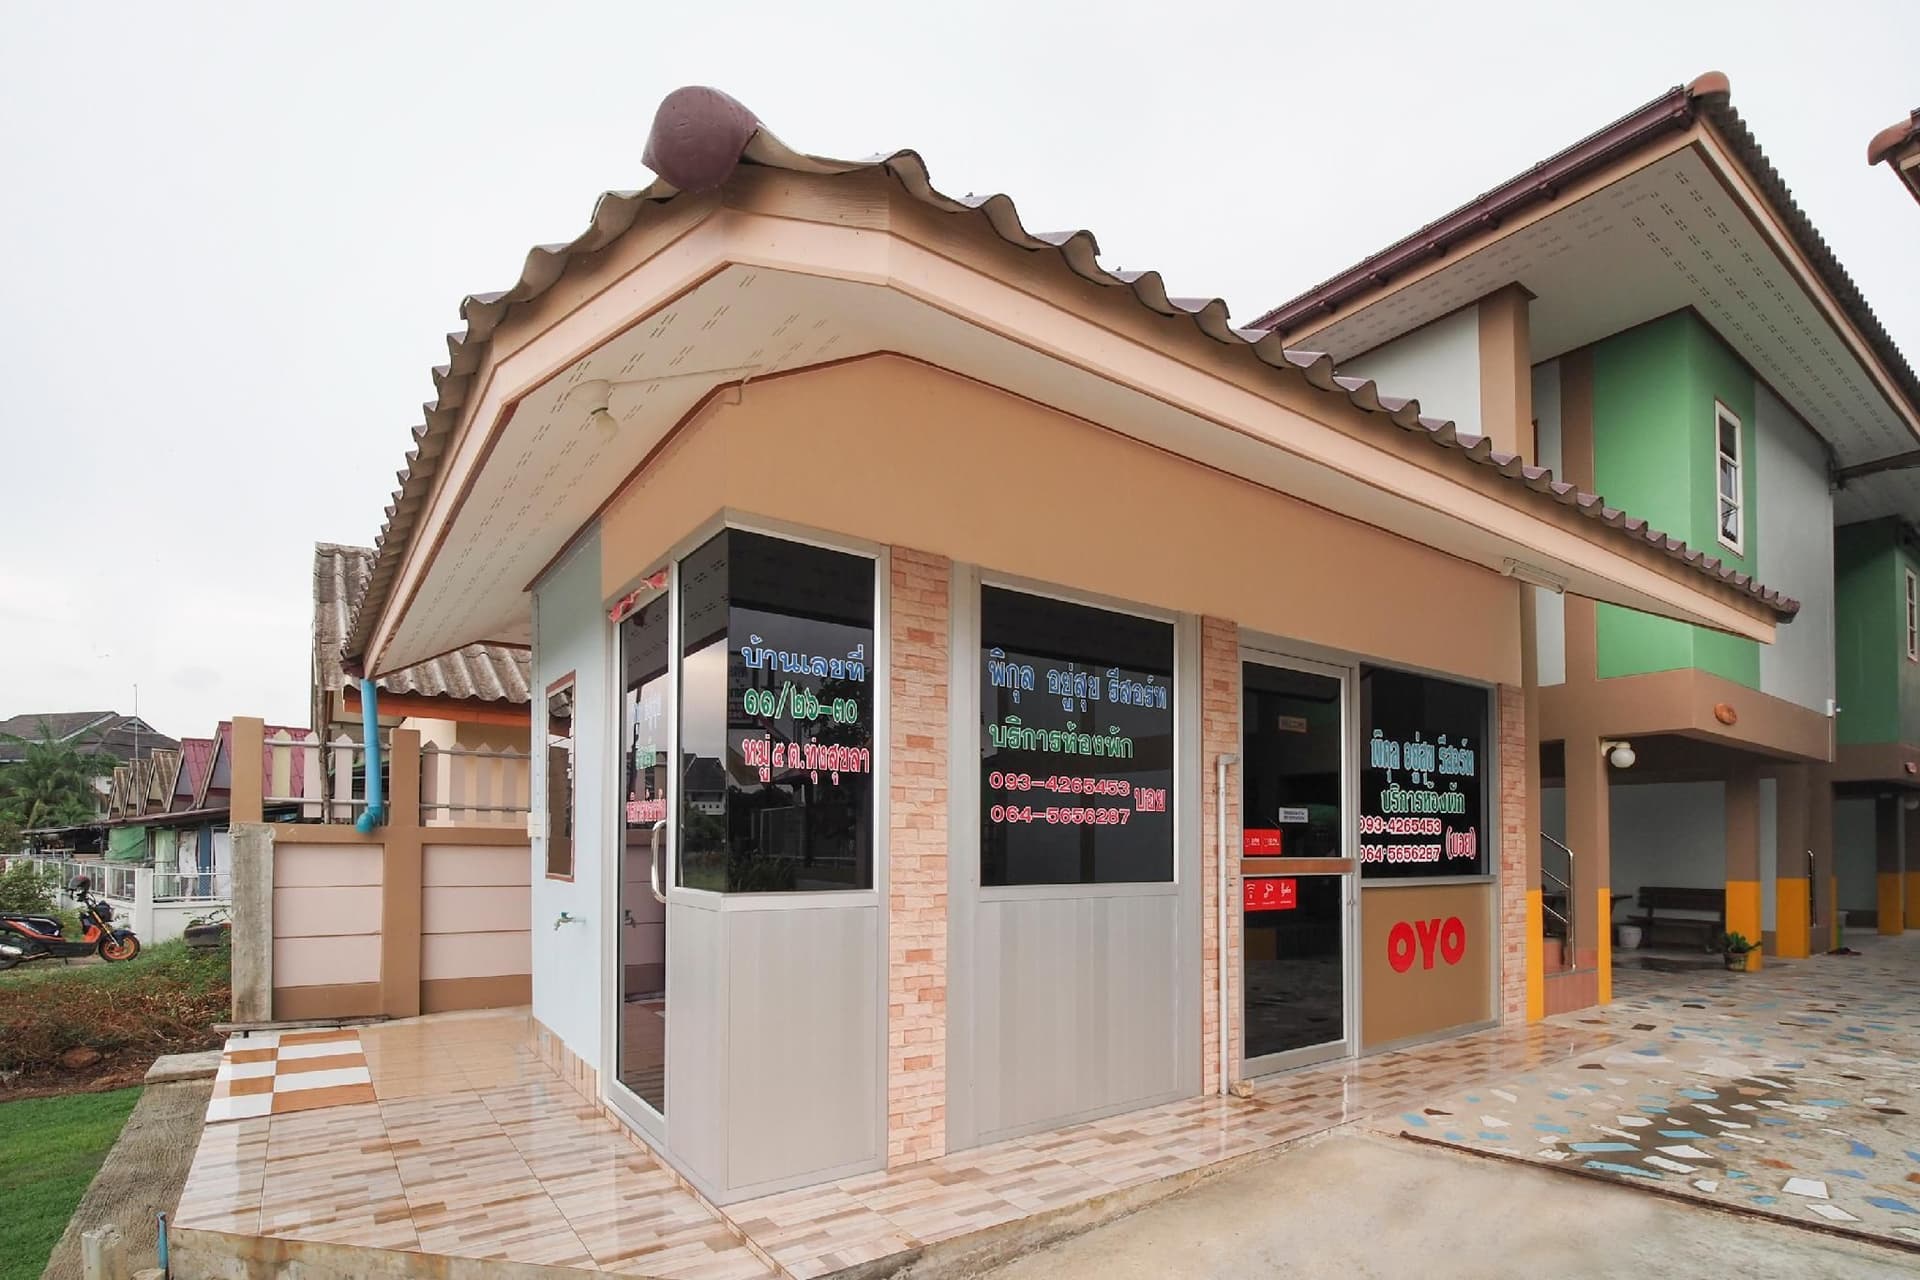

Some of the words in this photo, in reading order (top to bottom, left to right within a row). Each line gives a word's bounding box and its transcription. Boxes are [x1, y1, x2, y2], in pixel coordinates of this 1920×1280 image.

[741, 634, 864, 682] บ้านเลขที่
[988, 647, 1035, 703] พิกุล
[1047, 663, 1100, 712] อยู่สุข
[1107, 667, 1167, 709] รีสอร์ท
[744, 681, 857, 723] ๑๑/๒๖-๓๐
[989, 715, 1134, 758] บริการห้องพัก
[1370, 729, 1400, 783] พิกุล
[742, 734, 770, 782] หมู่
[989, 772, 1130, 796] 093-4265453
[1134, 787, 1166, 812] บอย
[1381, 781, 1466, 813] บริการห้องพัก
[991, 805, 1130, 825] 064-5656287
[1446, 825, 1476, 860] (บอย)
[1387, 916, 1466, 973] OYO
